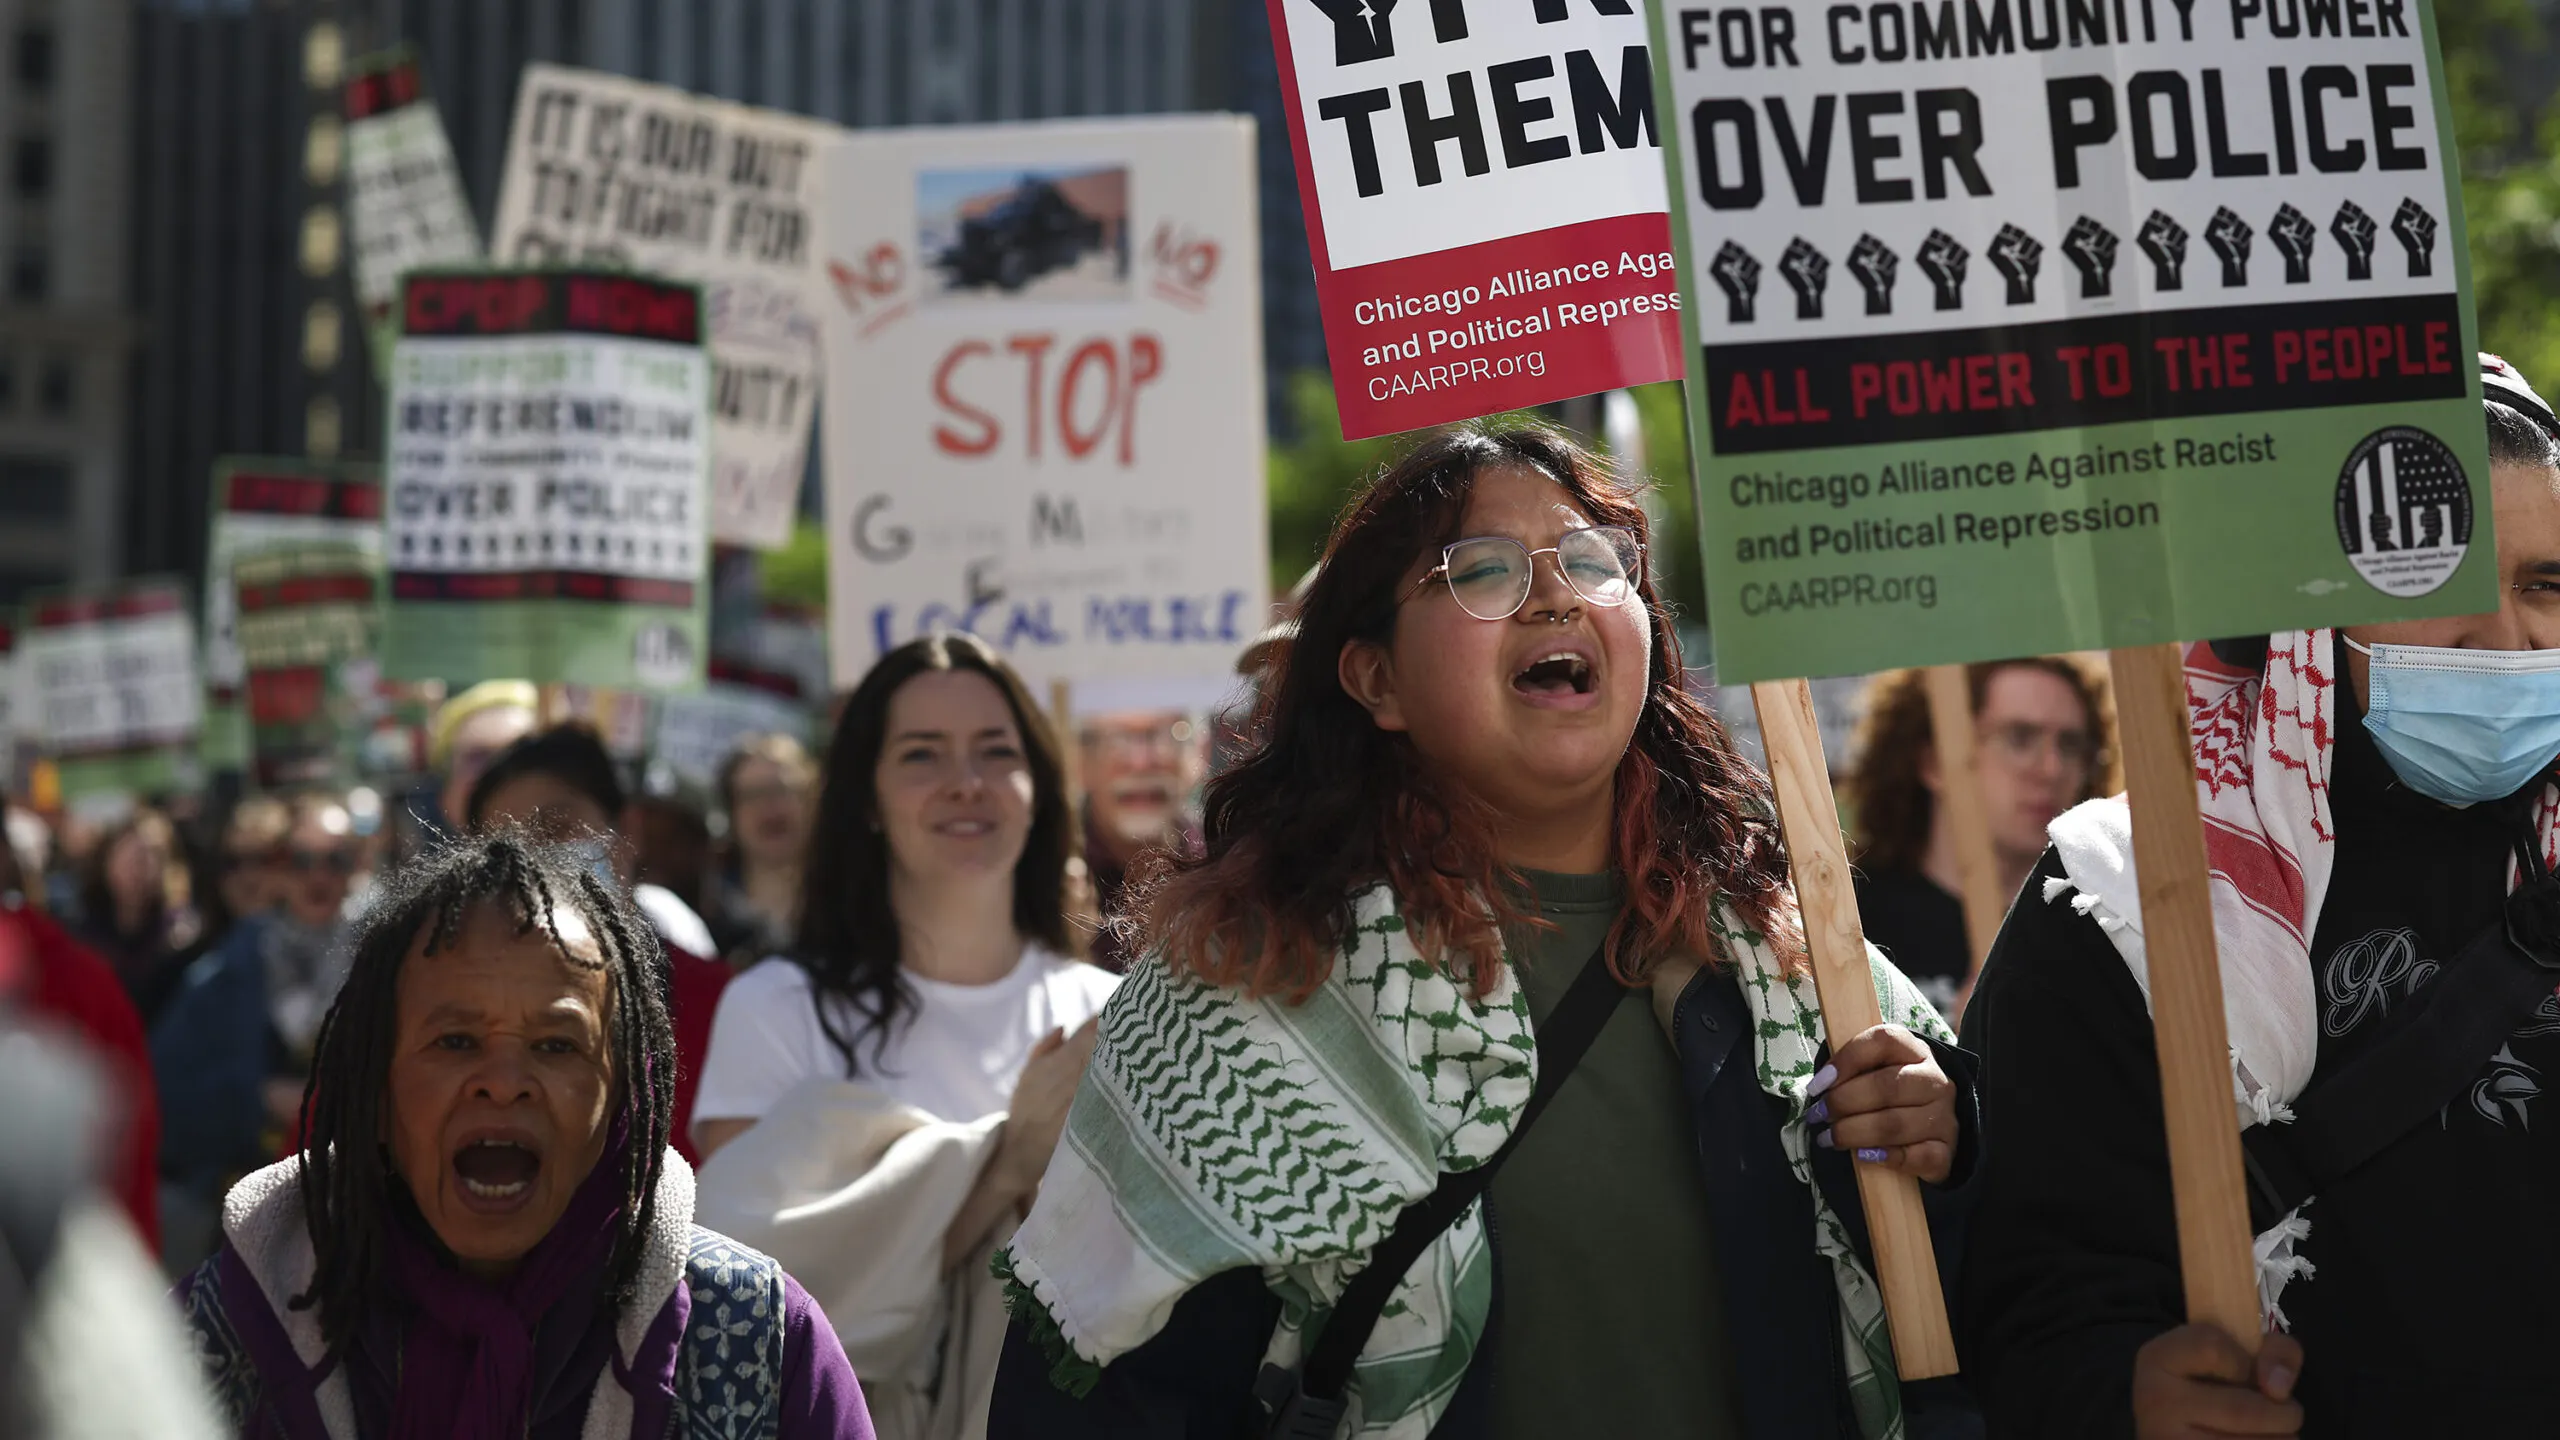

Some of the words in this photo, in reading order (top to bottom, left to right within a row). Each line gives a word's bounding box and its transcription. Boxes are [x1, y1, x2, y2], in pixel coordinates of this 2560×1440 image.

[1680, 8, 1801, 71] FOR
[1827, 0, 2193, 65] COMMUNITY
[2232, 0, 2410, 39] POWER
[1318, 46, 1663, 198] THEM
[1692, 87, 1994, 211] OVER
[2046, 64, 2427, 189] POLICE
[1354, 285, 1481, 326] Chicago
[1487, 258, 1610, 301] Alliance
[1362, 333, 1421, 367] and
[1428, 306, 1551, 355] Political
[931, 332, 1163, 468] STOP
[1368, 350, 1546, 402] CAARPR.org
[1725, 367, 1831, 429] ALL
[1851, 352, 2036, 420] POWER
[2056, 342, 2132, 401] TO
[2154, 332, 2253, 393] THE
[2273, 321, 2452, 385] PEOPLE
[1730, 471, 1870, 508] Chicago
[1878, 459, 2016, 495] Alliance
[2025, 441, 2164, 489] Against
[2174, 432, 2277, 467] Racist
[1736, 526, 1800, 563] and
[1809, 512, 1946, 556] Political
[1954, 498, 2160, 549] Repression
[1739, 572, 1938, 617] CAARPR.org
